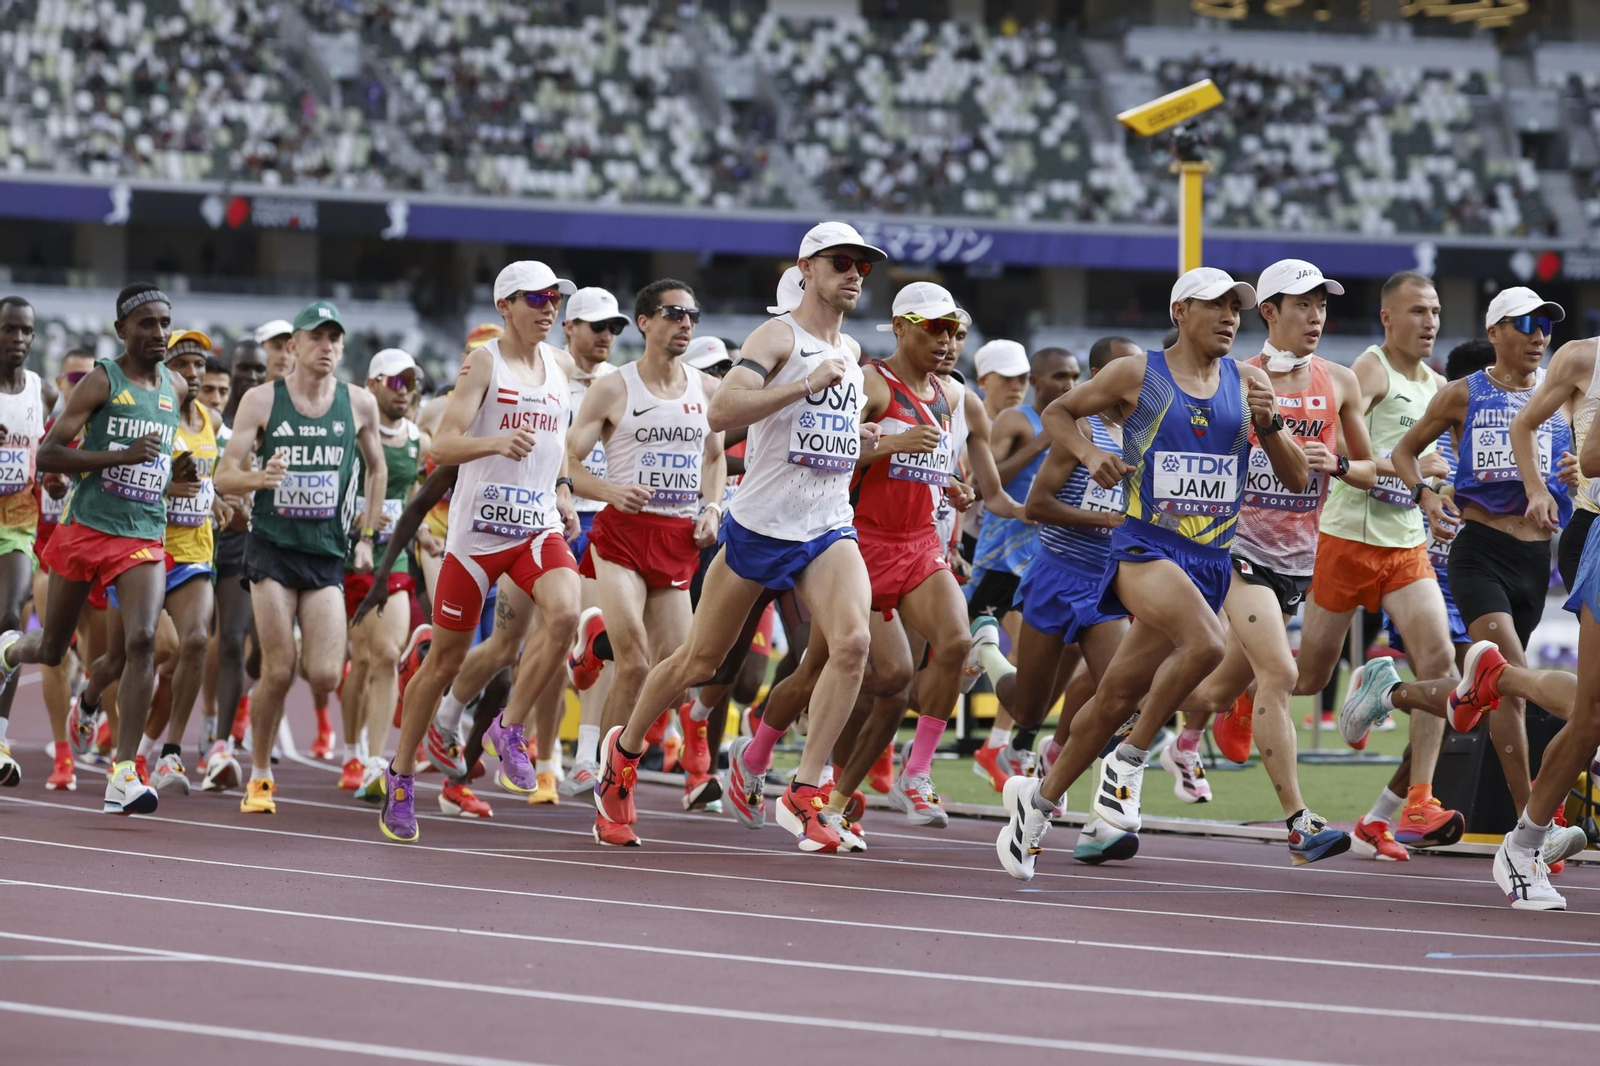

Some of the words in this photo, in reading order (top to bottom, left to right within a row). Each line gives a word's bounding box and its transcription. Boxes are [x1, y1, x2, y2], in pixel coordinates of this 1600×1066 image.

[107, 416, 173, 445] ETHIOPIA
[298, 426, 327, 437] 123.ie
[499, 412, 558, 433] AUSTRIA
[816, 413, 856, 433] TDK
[1286, 418, 1324, 437] PAN
[635, 427, 702, 442] CANADA
[796, 432, 857, 455] YOUNG
[275, 446, 344, 467] IRELAND
[656, 453, 697, 469] TDK
[896, 451, 949, 471] CHAMPI
[1180, 454, 1234, 476] TDK
[108, 465, 163, 490] GELETA
[293, 475, 333, 488] TDK
[638, 471, 698, 489] LEVINS
[1246, 472, 1318, 495] KOYA
[279, 490, 335, 505] LYNCH
[500, 486, 544, 507] TDK
[1169, 478, 1226, 499] JAMI
[480, 504, 545, 526] GRUEN
